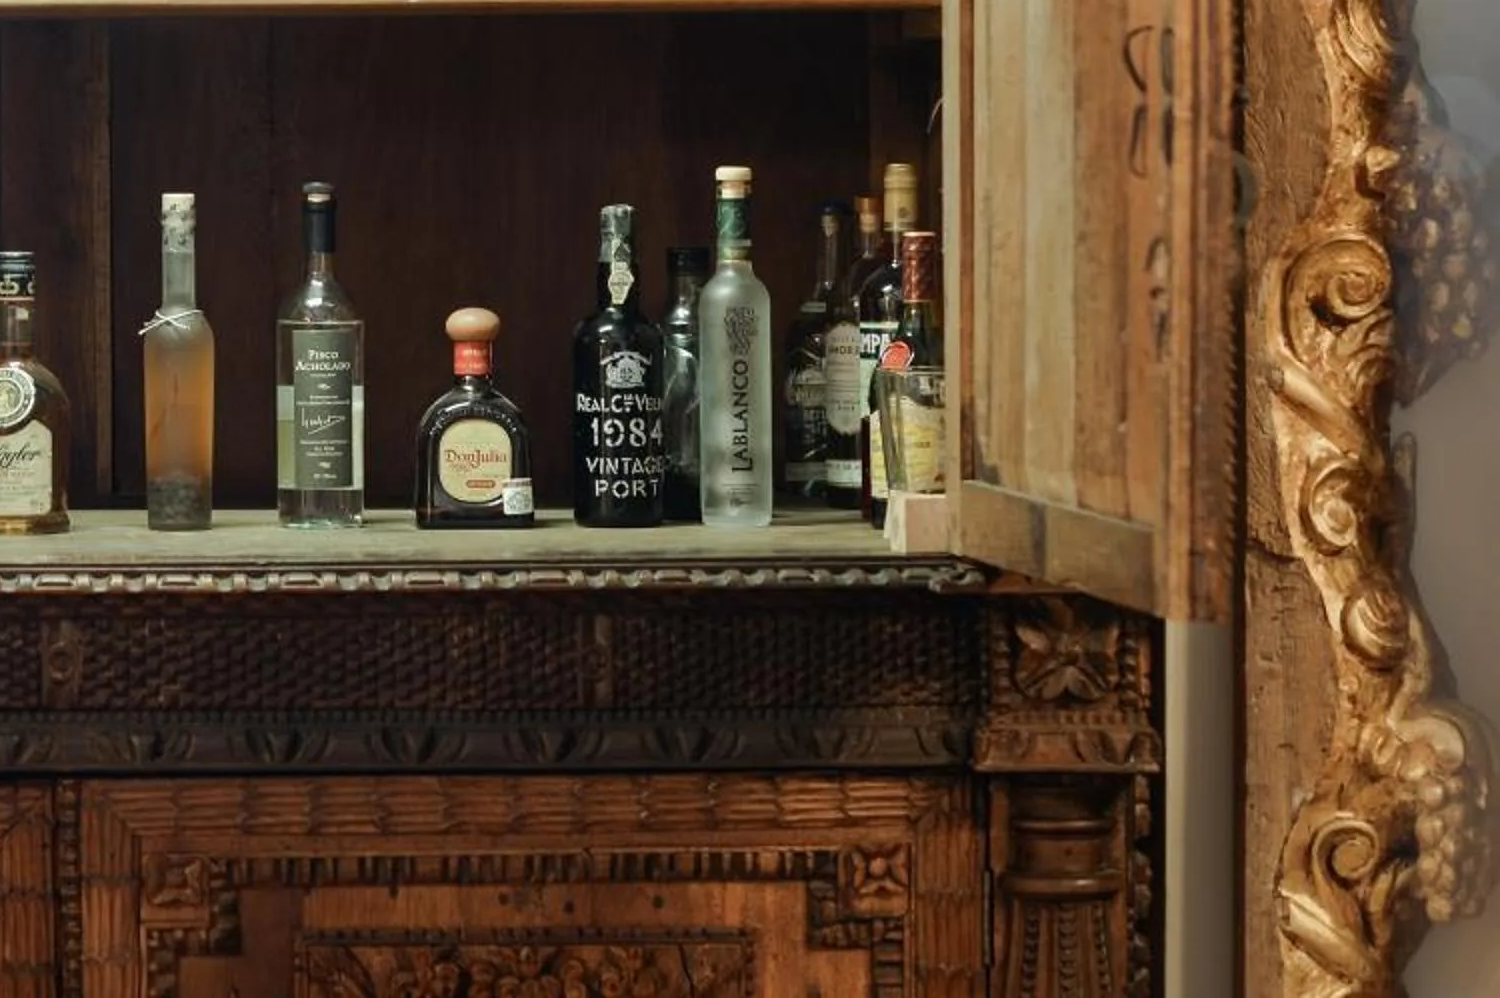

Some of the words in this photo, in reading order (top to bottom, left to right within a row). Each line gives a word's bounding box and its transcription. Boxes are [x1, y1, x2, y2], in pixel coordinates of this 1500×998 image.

[576, 393, 610, 412] REAL
[590, 417, 663, 447] 1984
[586, 457, 664, 475] VINTAGE
[595, 480, 660, 499] PORT
